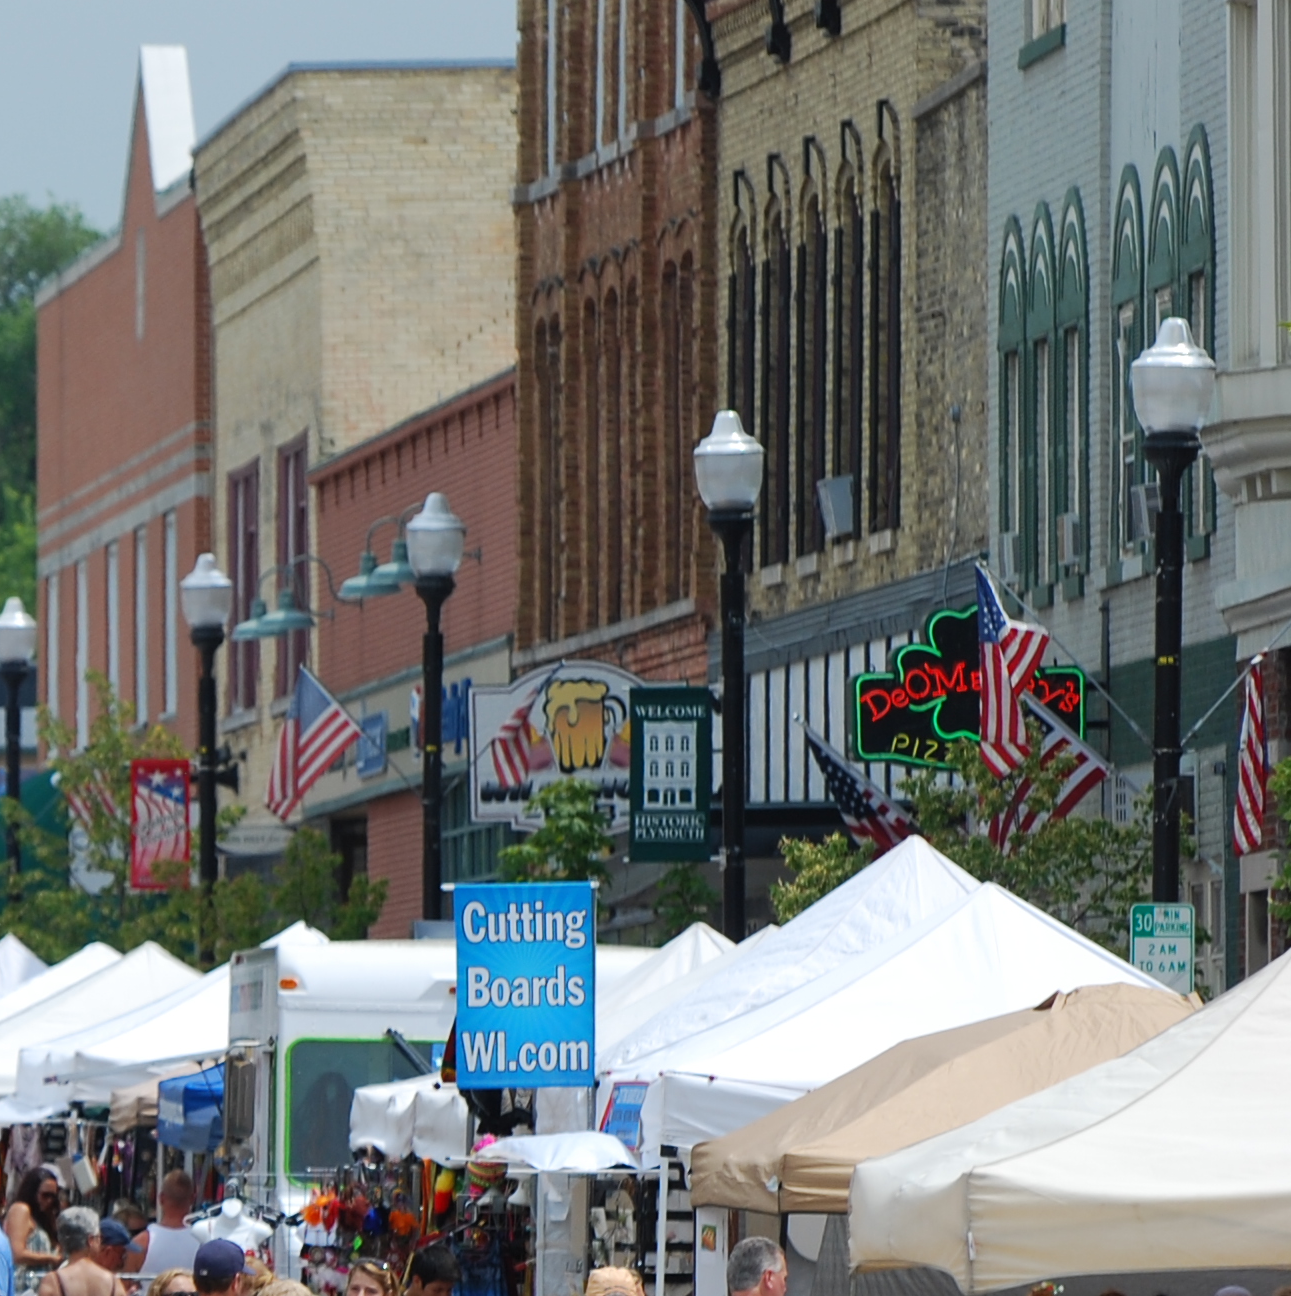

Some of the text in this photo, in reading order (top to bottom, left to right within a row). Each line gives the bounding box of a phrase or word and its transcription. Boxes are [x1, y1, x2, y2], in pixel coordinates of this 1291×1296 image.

[634, 705, 706, 719] WELCOME
[634, 814, 706, 827] HISTORIC
[634, 827, 705, 840] PLYMOUTH
[462, 900, 587, 949] Cutting
[1134, 910, 1181, 932] 30 MIN
[1154, 922, 1190, 933] PARKING
[1148, 944, 1177, 956] 2 AM
[1139, 961, 1186, 973] TO 6 AM
[467, 965, 585, 1008] Boards
[462, 1030, 590, 1073] WI.com
